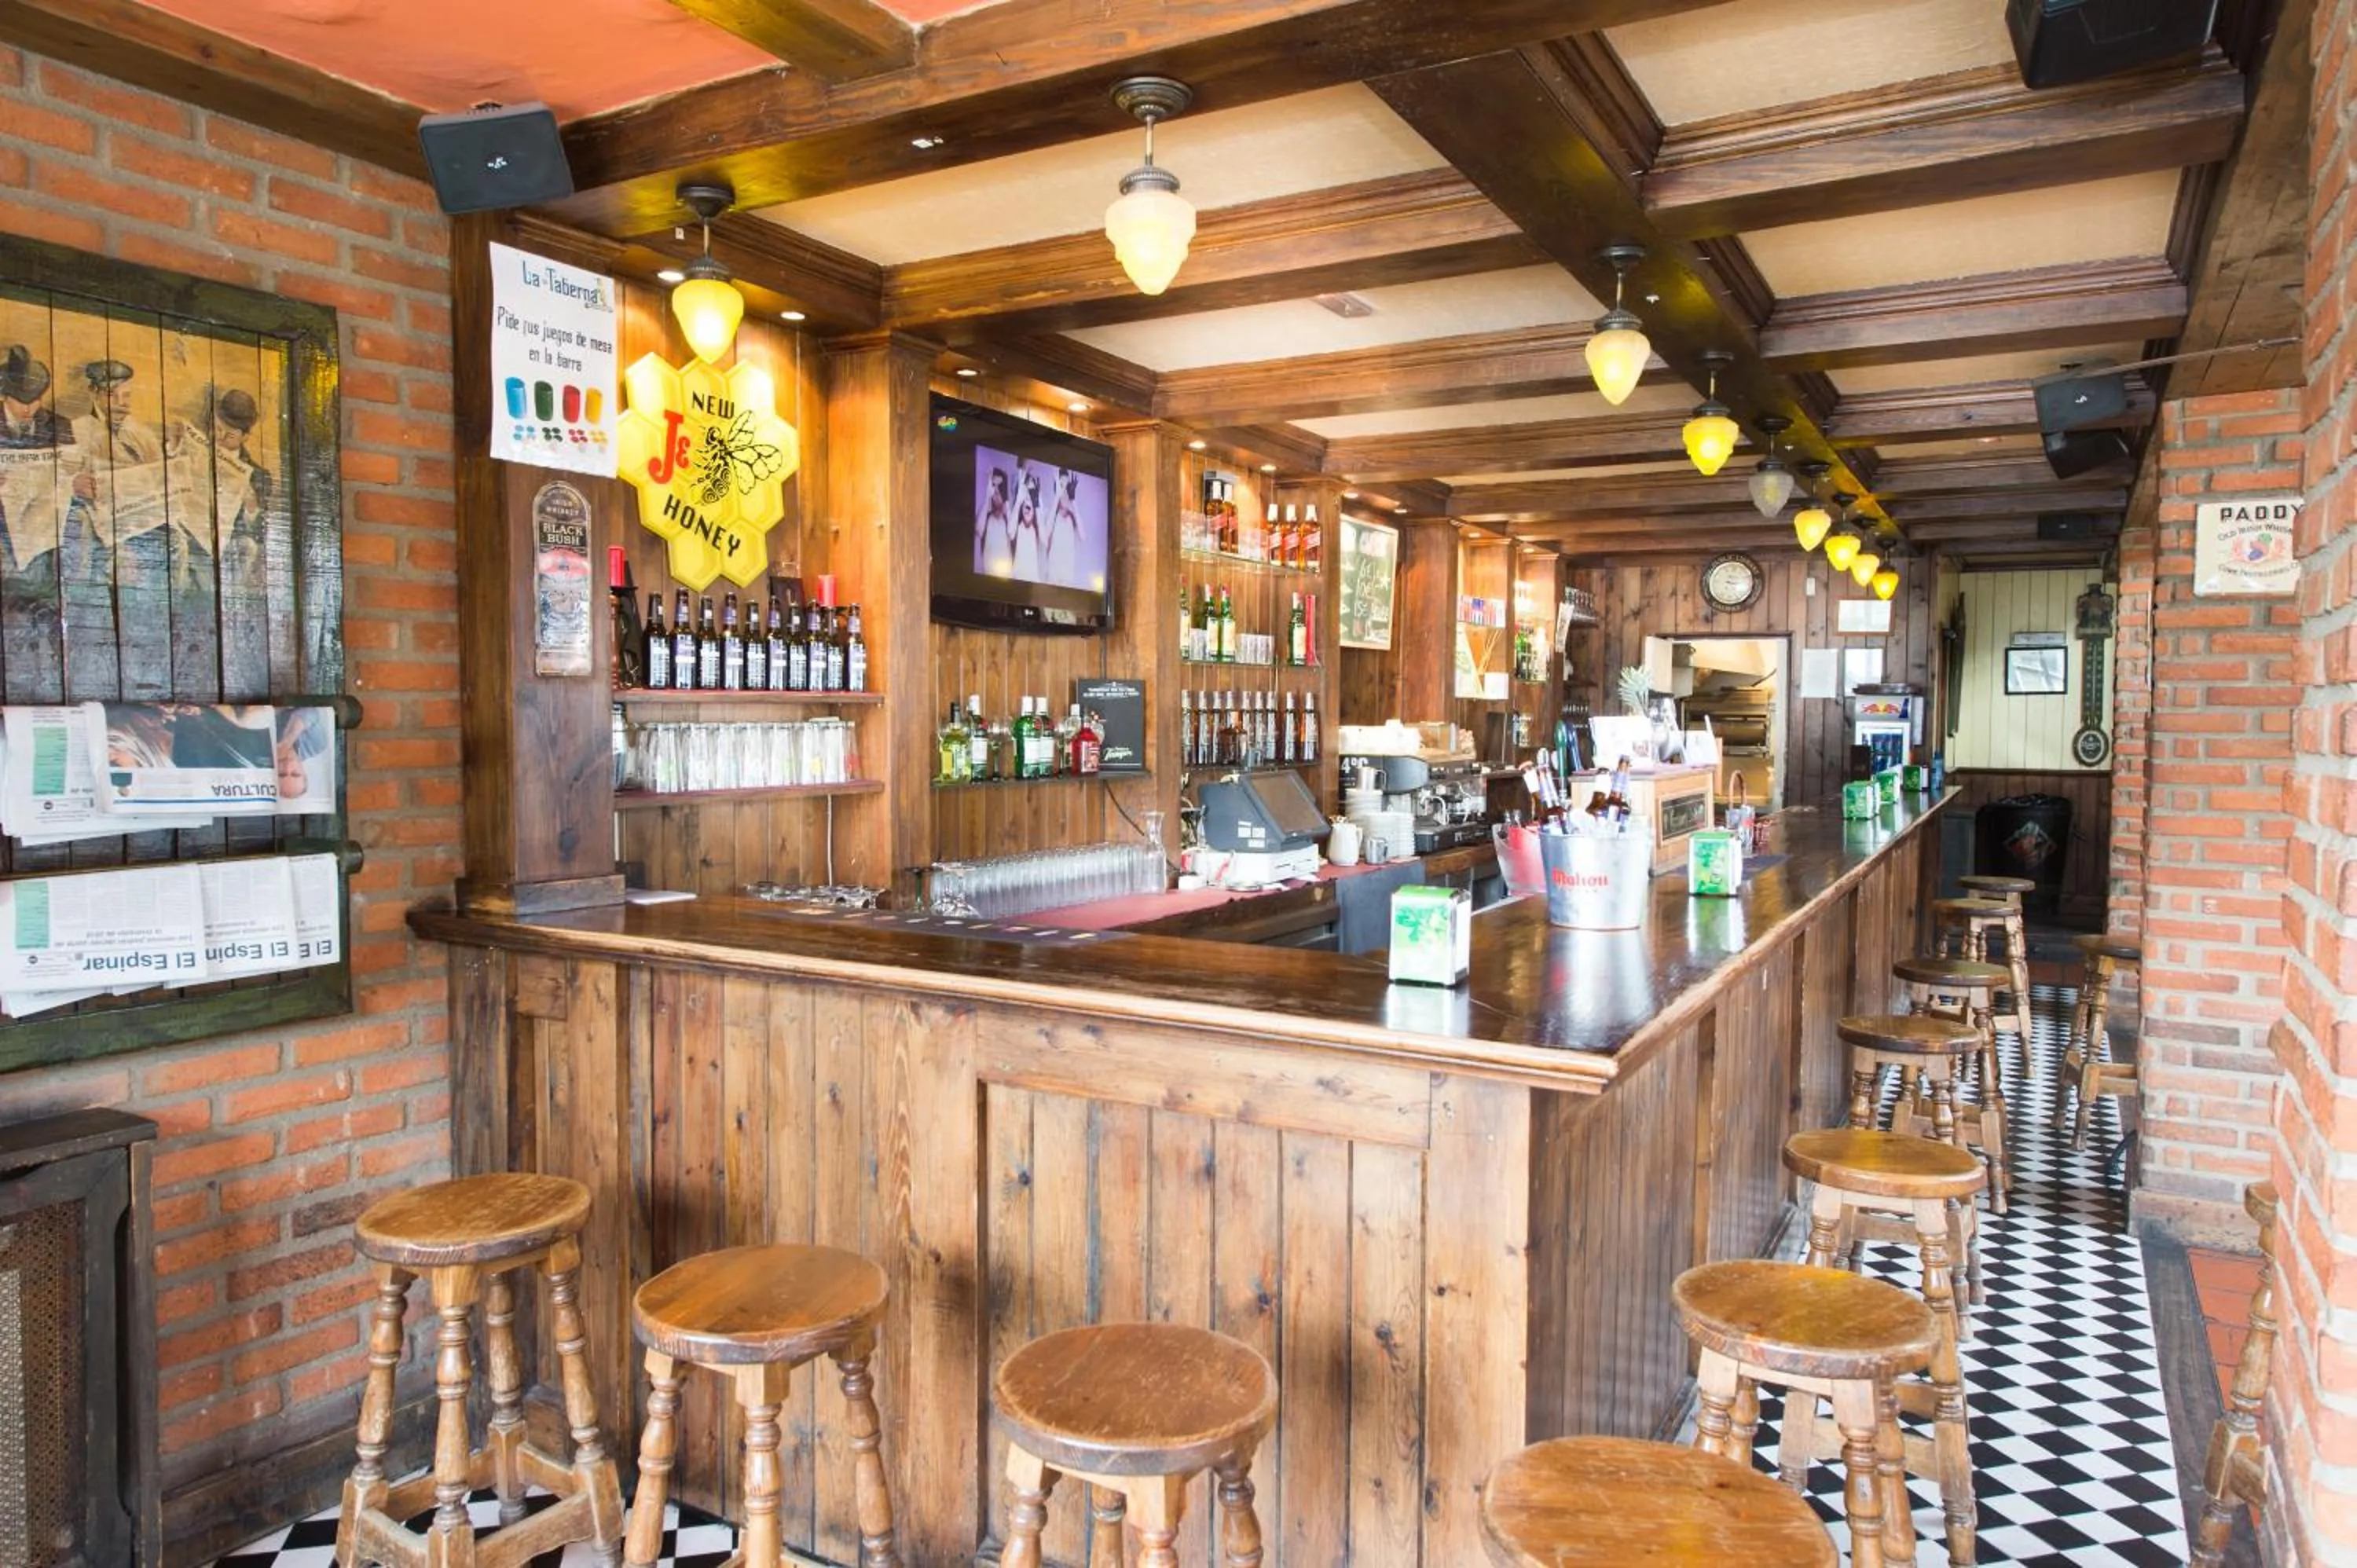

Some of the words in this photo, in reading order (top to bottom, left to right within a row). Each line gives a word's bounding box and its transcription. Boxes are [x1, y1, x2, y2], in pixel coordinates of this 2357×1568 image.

[522, 260, 540, 287] La
[546, 267, 598, 303] Taberna
[497, 306, 519, 330] Pide
[542, 320, 572, 346] juegos
[576, 331, 587, 347] de
[591, 339, 612, 354] mesa
[529, 348, 540, 361] en
[544, 346, 552, 365] la
[557, 351, 582, 372] barra
[691, 391, 735, 419] NEW
[543, 522, 584, 536] BLACK
[664, 494, 741, 557] HONEY
[547, 534, 580, 546] BUSH
[211, 784, 277, 797] CULTURA
[270, 941, 288, 957] El
[316, 940, 332, 955] El
[82, 951, 167, 973] Espinar
[176, 952, 196, 969] El
